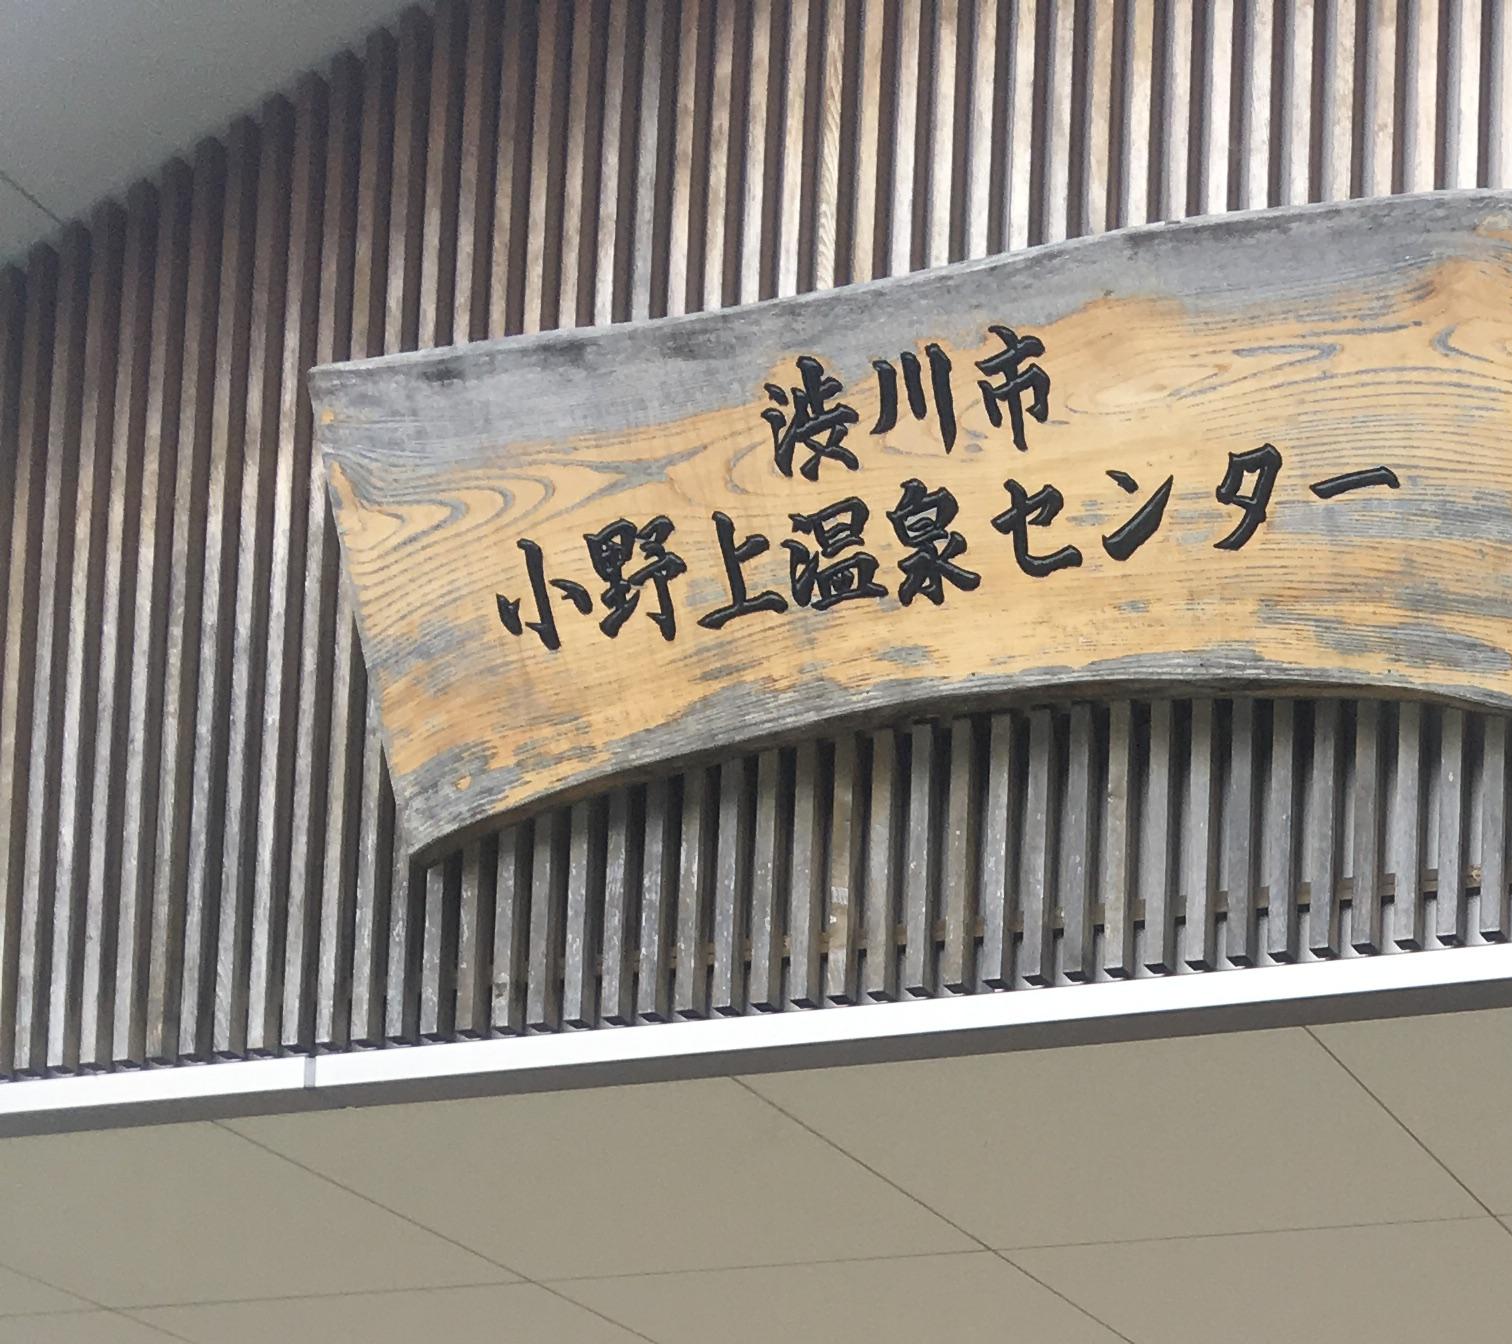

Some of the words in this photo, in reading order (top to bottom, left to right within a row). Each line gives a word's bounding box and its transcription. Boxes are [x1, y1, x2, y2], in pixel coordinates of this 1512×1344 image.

[759, 324, 1053, 482] 渋川市
[495, 442, 1401, 651] 小野上温泉センター
